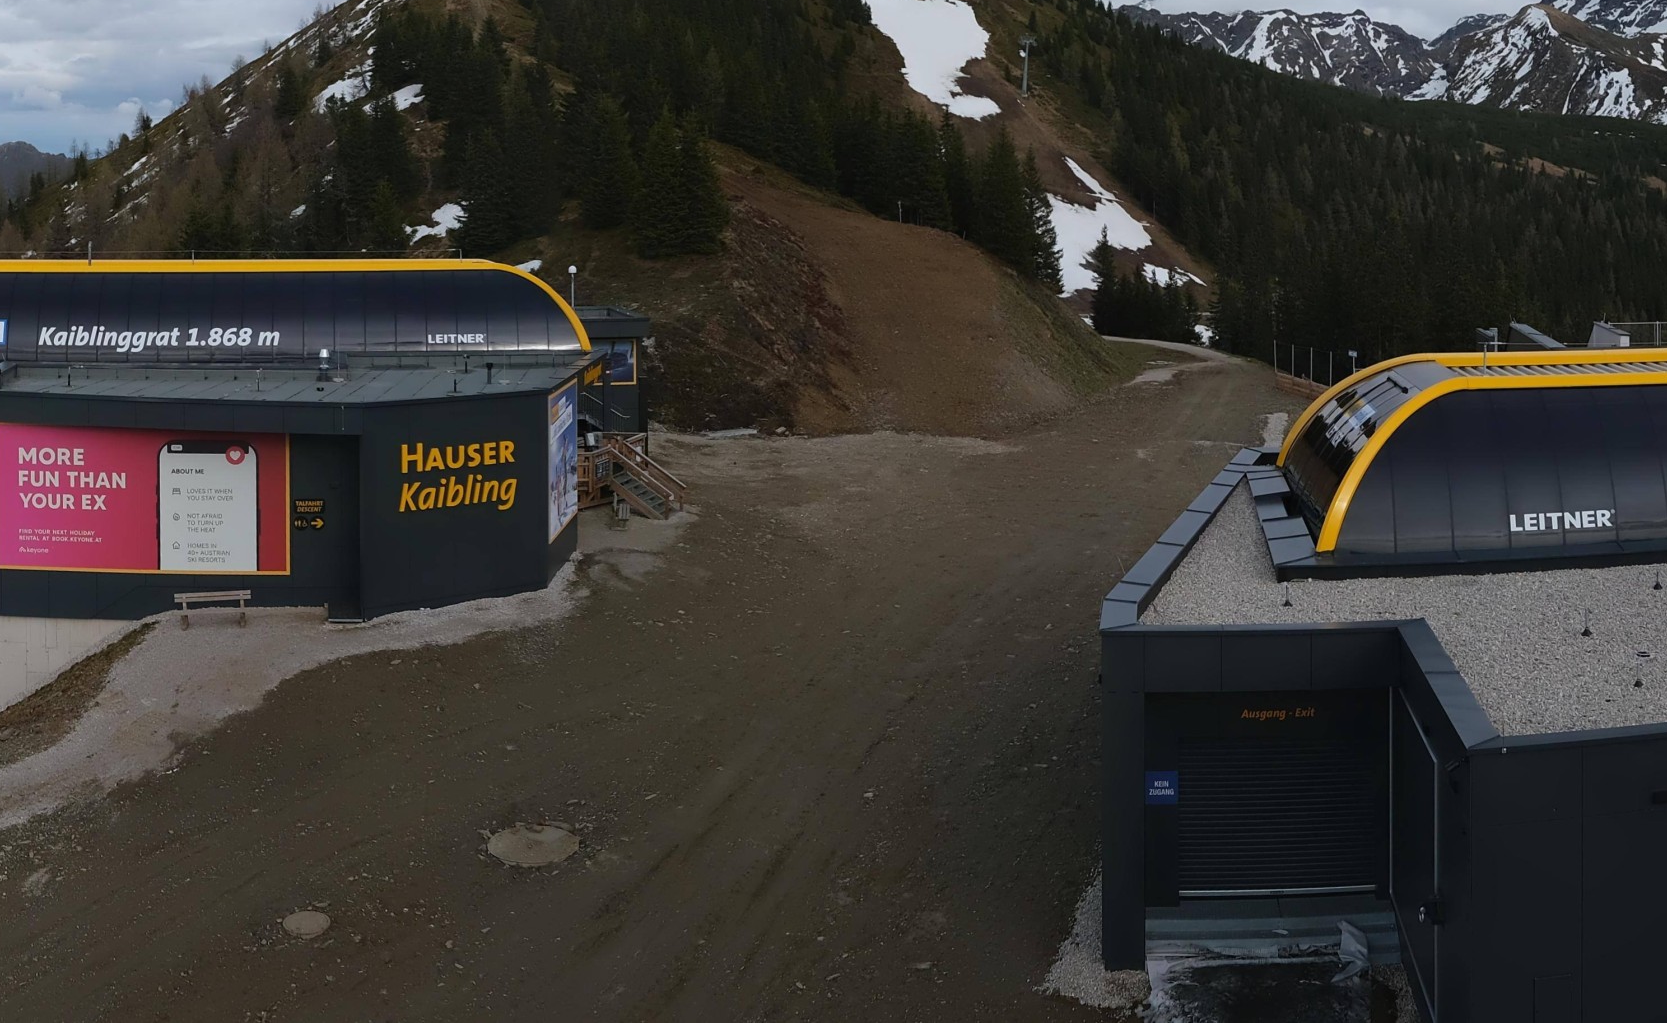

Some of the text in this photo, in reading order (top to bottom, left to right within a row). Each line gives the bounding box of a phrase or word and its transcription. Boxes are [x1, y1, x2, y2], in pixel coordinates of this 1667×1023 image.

[38, 326, 280, 352] Kaiblinggrat 1.868 m
[427, 333, 485, 344] LEITNER
[18, 447, 84, 466] MORE
[401, 440, 516, 474] HAUSER
[18, 470, 126, 489] FUN THAN
[20, 493, 107, 510] YOUR EX
[399, 474, 518, 513] Kaibling
[1509, 509, 1613, 532] LEITNER
[1240, 708, 1287, 721] Ausgang
[1295, 707, 1316, 717] Exit
[1149, 788, 1175, 796] ZUGANG
